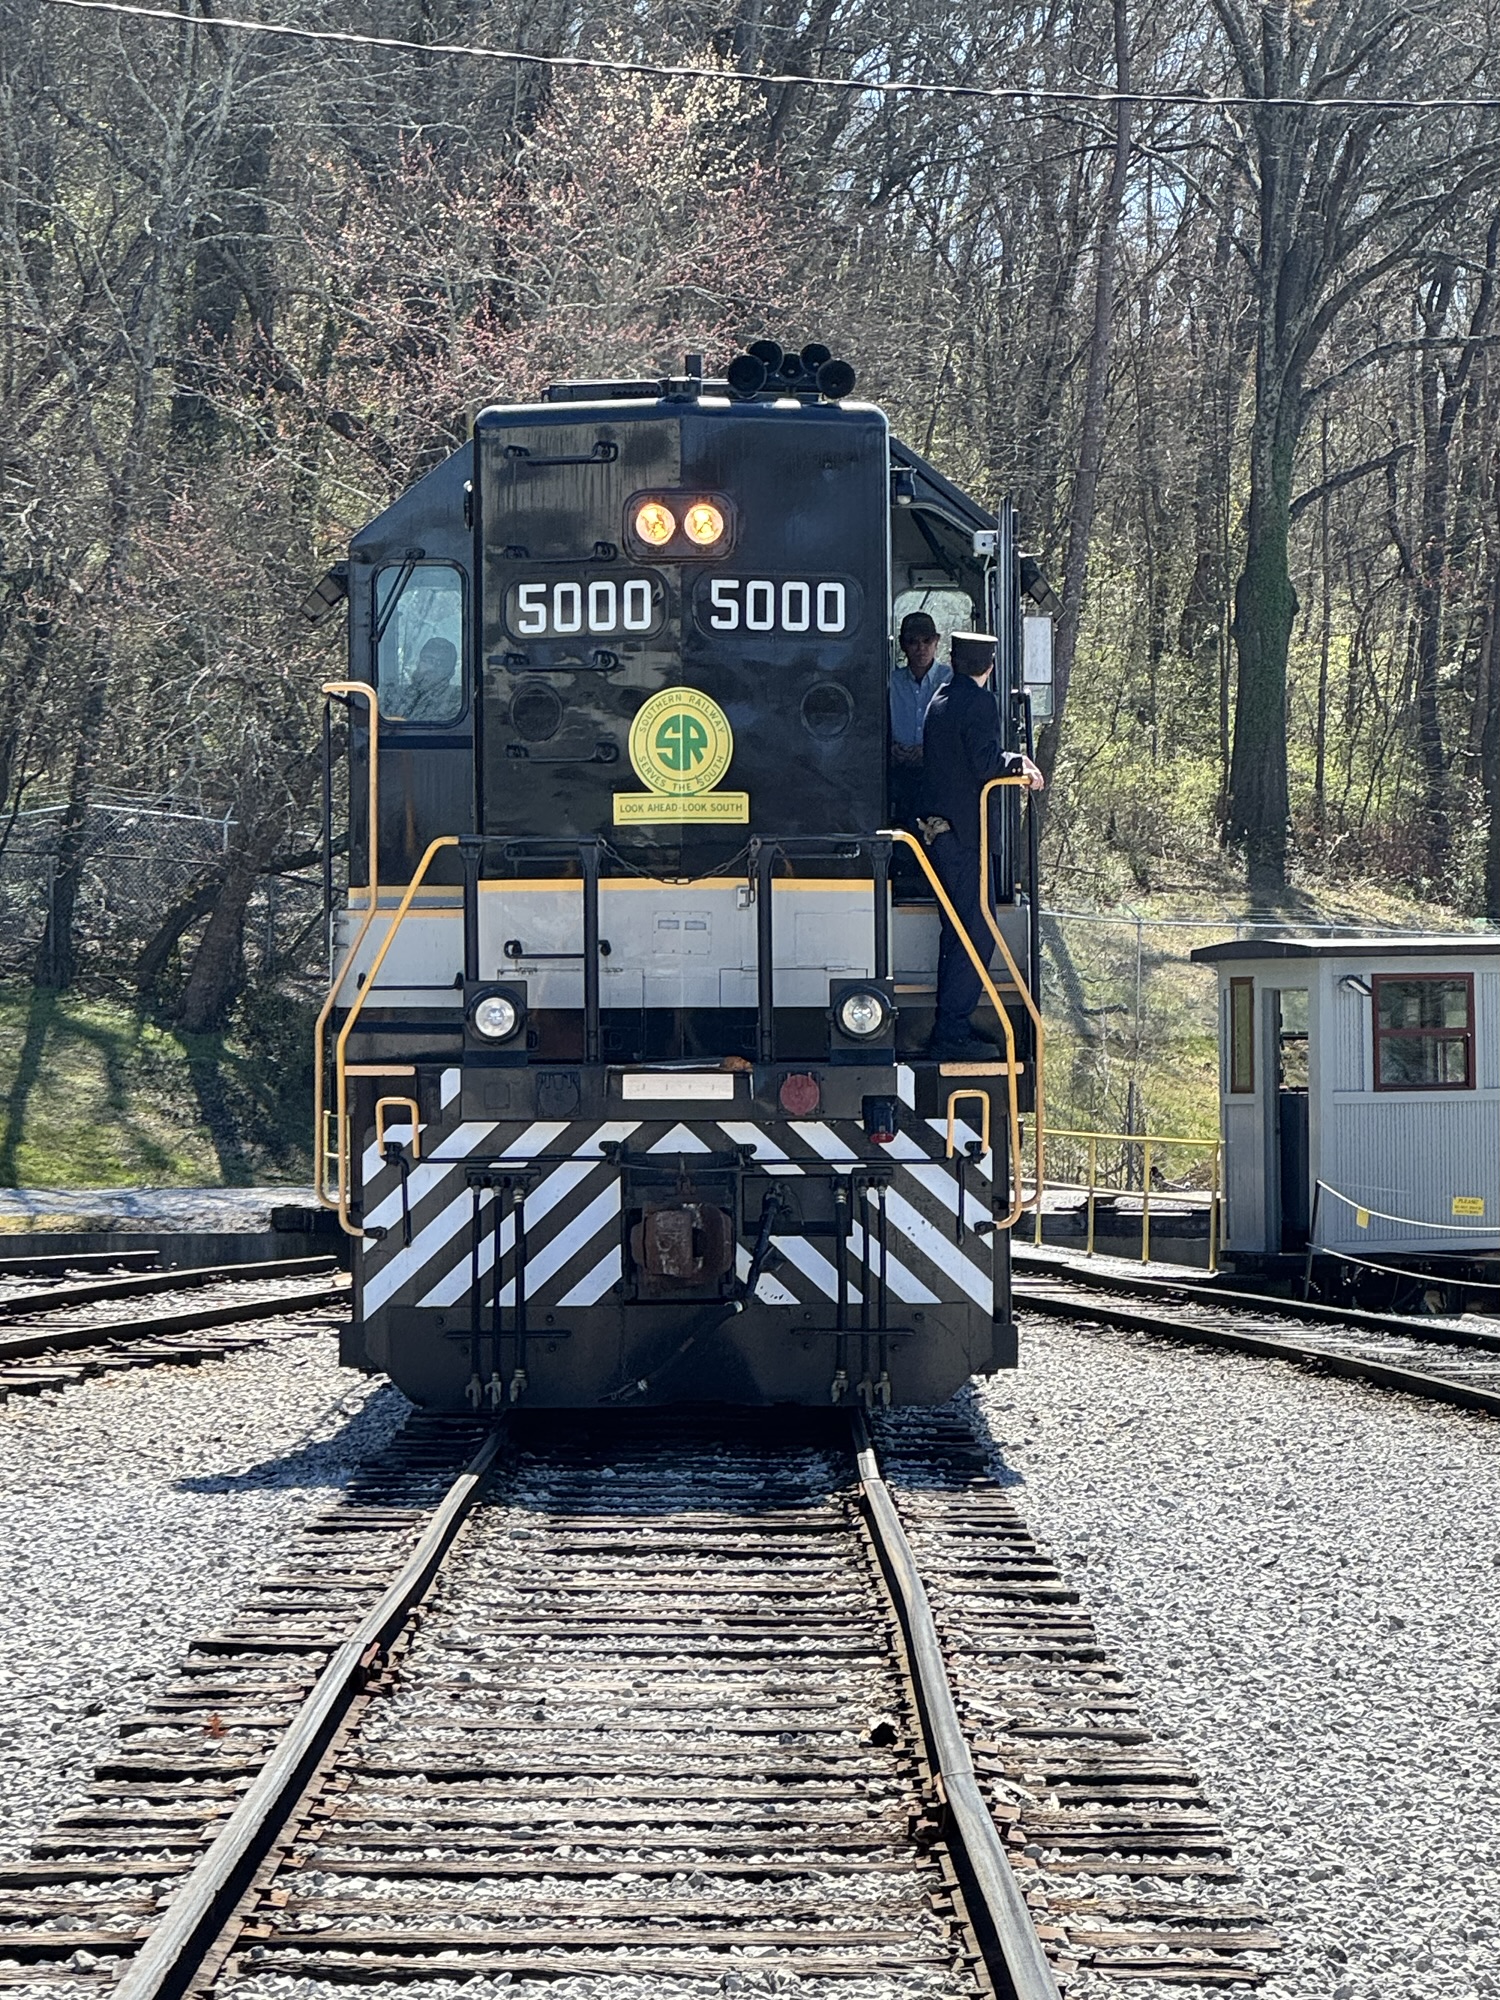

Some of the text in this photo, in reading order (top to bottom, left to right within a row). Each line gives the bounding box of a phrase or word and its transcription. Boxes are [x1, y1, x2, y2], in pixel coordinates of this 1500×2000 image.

[518, 579, 651, 633] 5000
[711, 579, 846, 632] 5000
[639, 693, 725, 733] SOUTHERN RAILWAY
[655, 714, 708, 771] SR
[638, 755, 725, 792] SERVES THE SOUTH
[620, 804, 644, 813] LOOK
[711, 802, 743, 812] SOUTH
